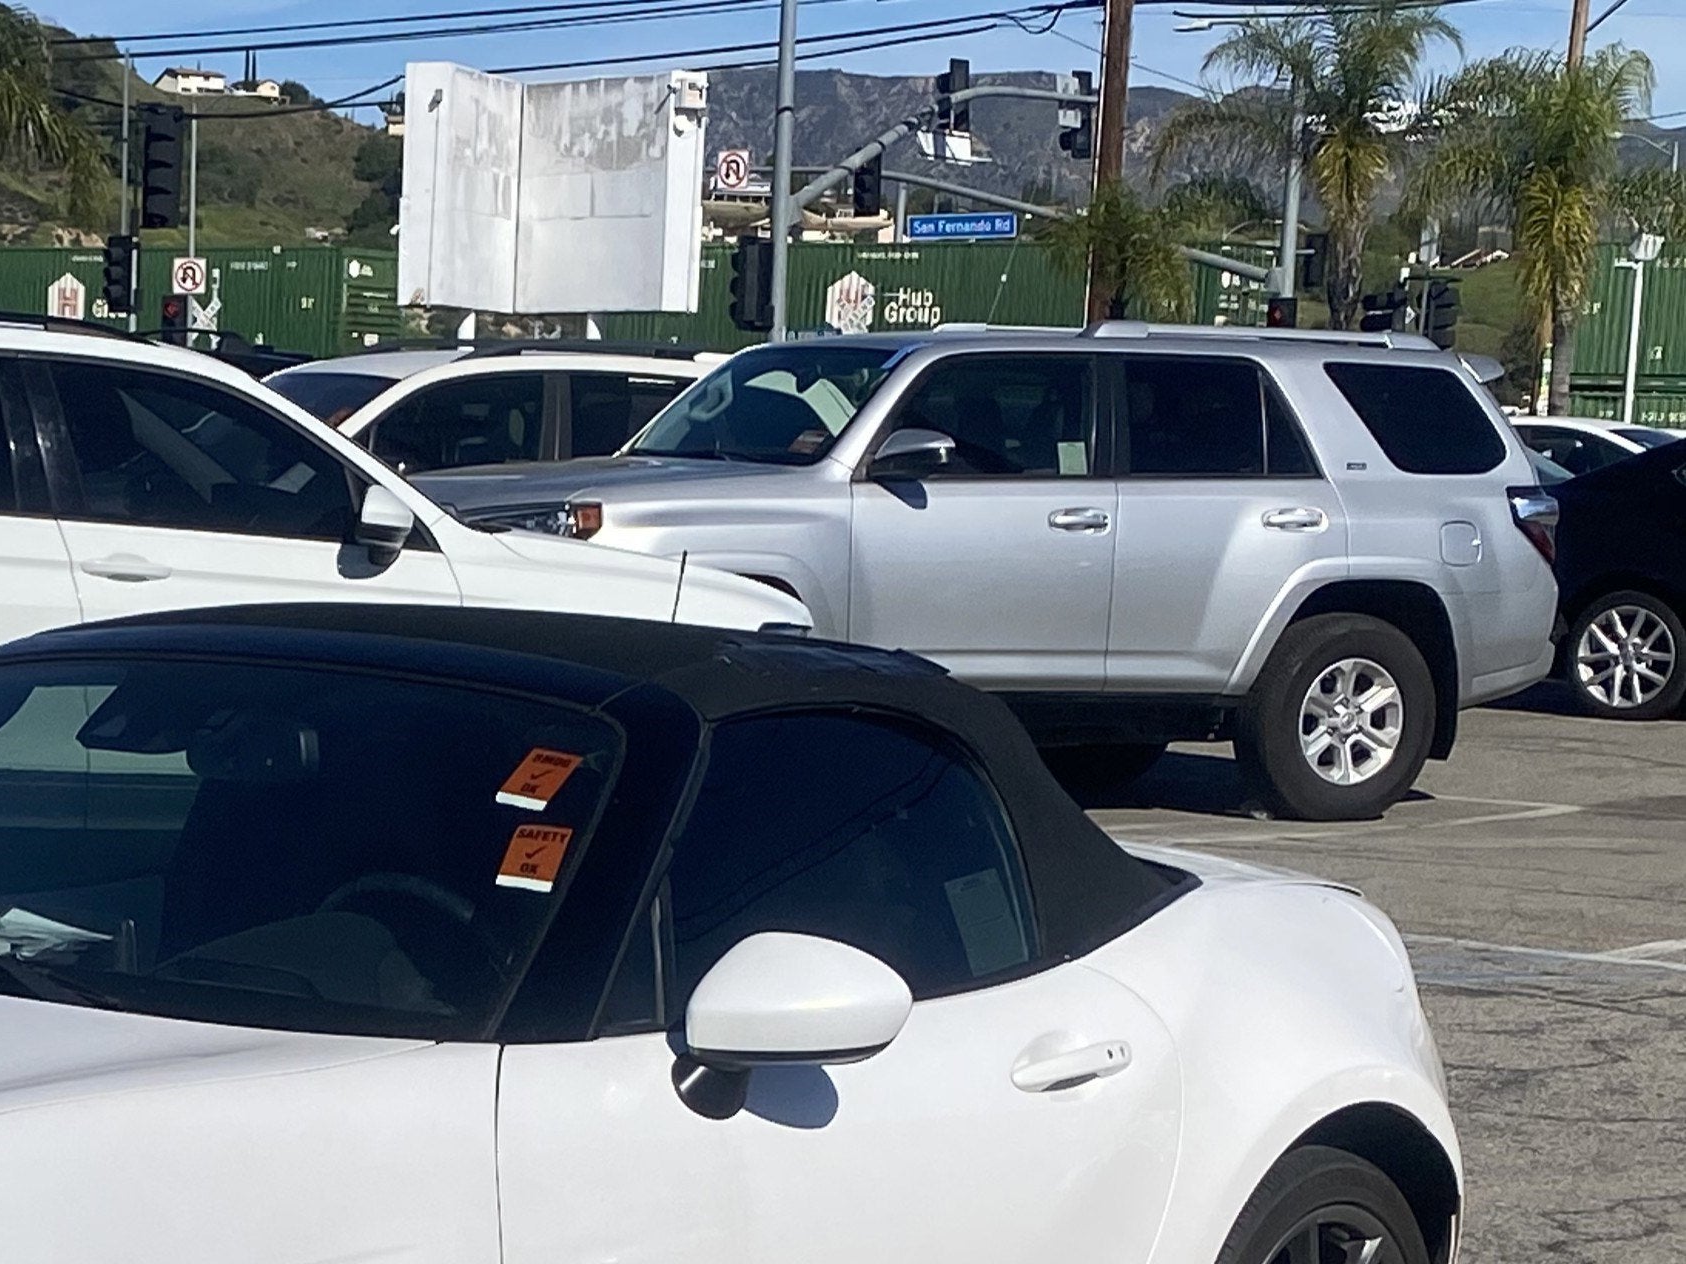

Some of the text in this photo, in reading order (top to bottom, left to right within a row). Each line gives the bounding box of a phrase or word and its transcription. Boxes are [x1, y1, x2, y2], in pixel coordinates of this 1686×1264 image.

[914, 218, 1010, 234] San Fernando Rd
[898, 287, 933, 307] Hub
[883, 301, 941, 328] Group
[517, 828, 568, 844] SAFETY
[519, 862, 539, 875] OK
